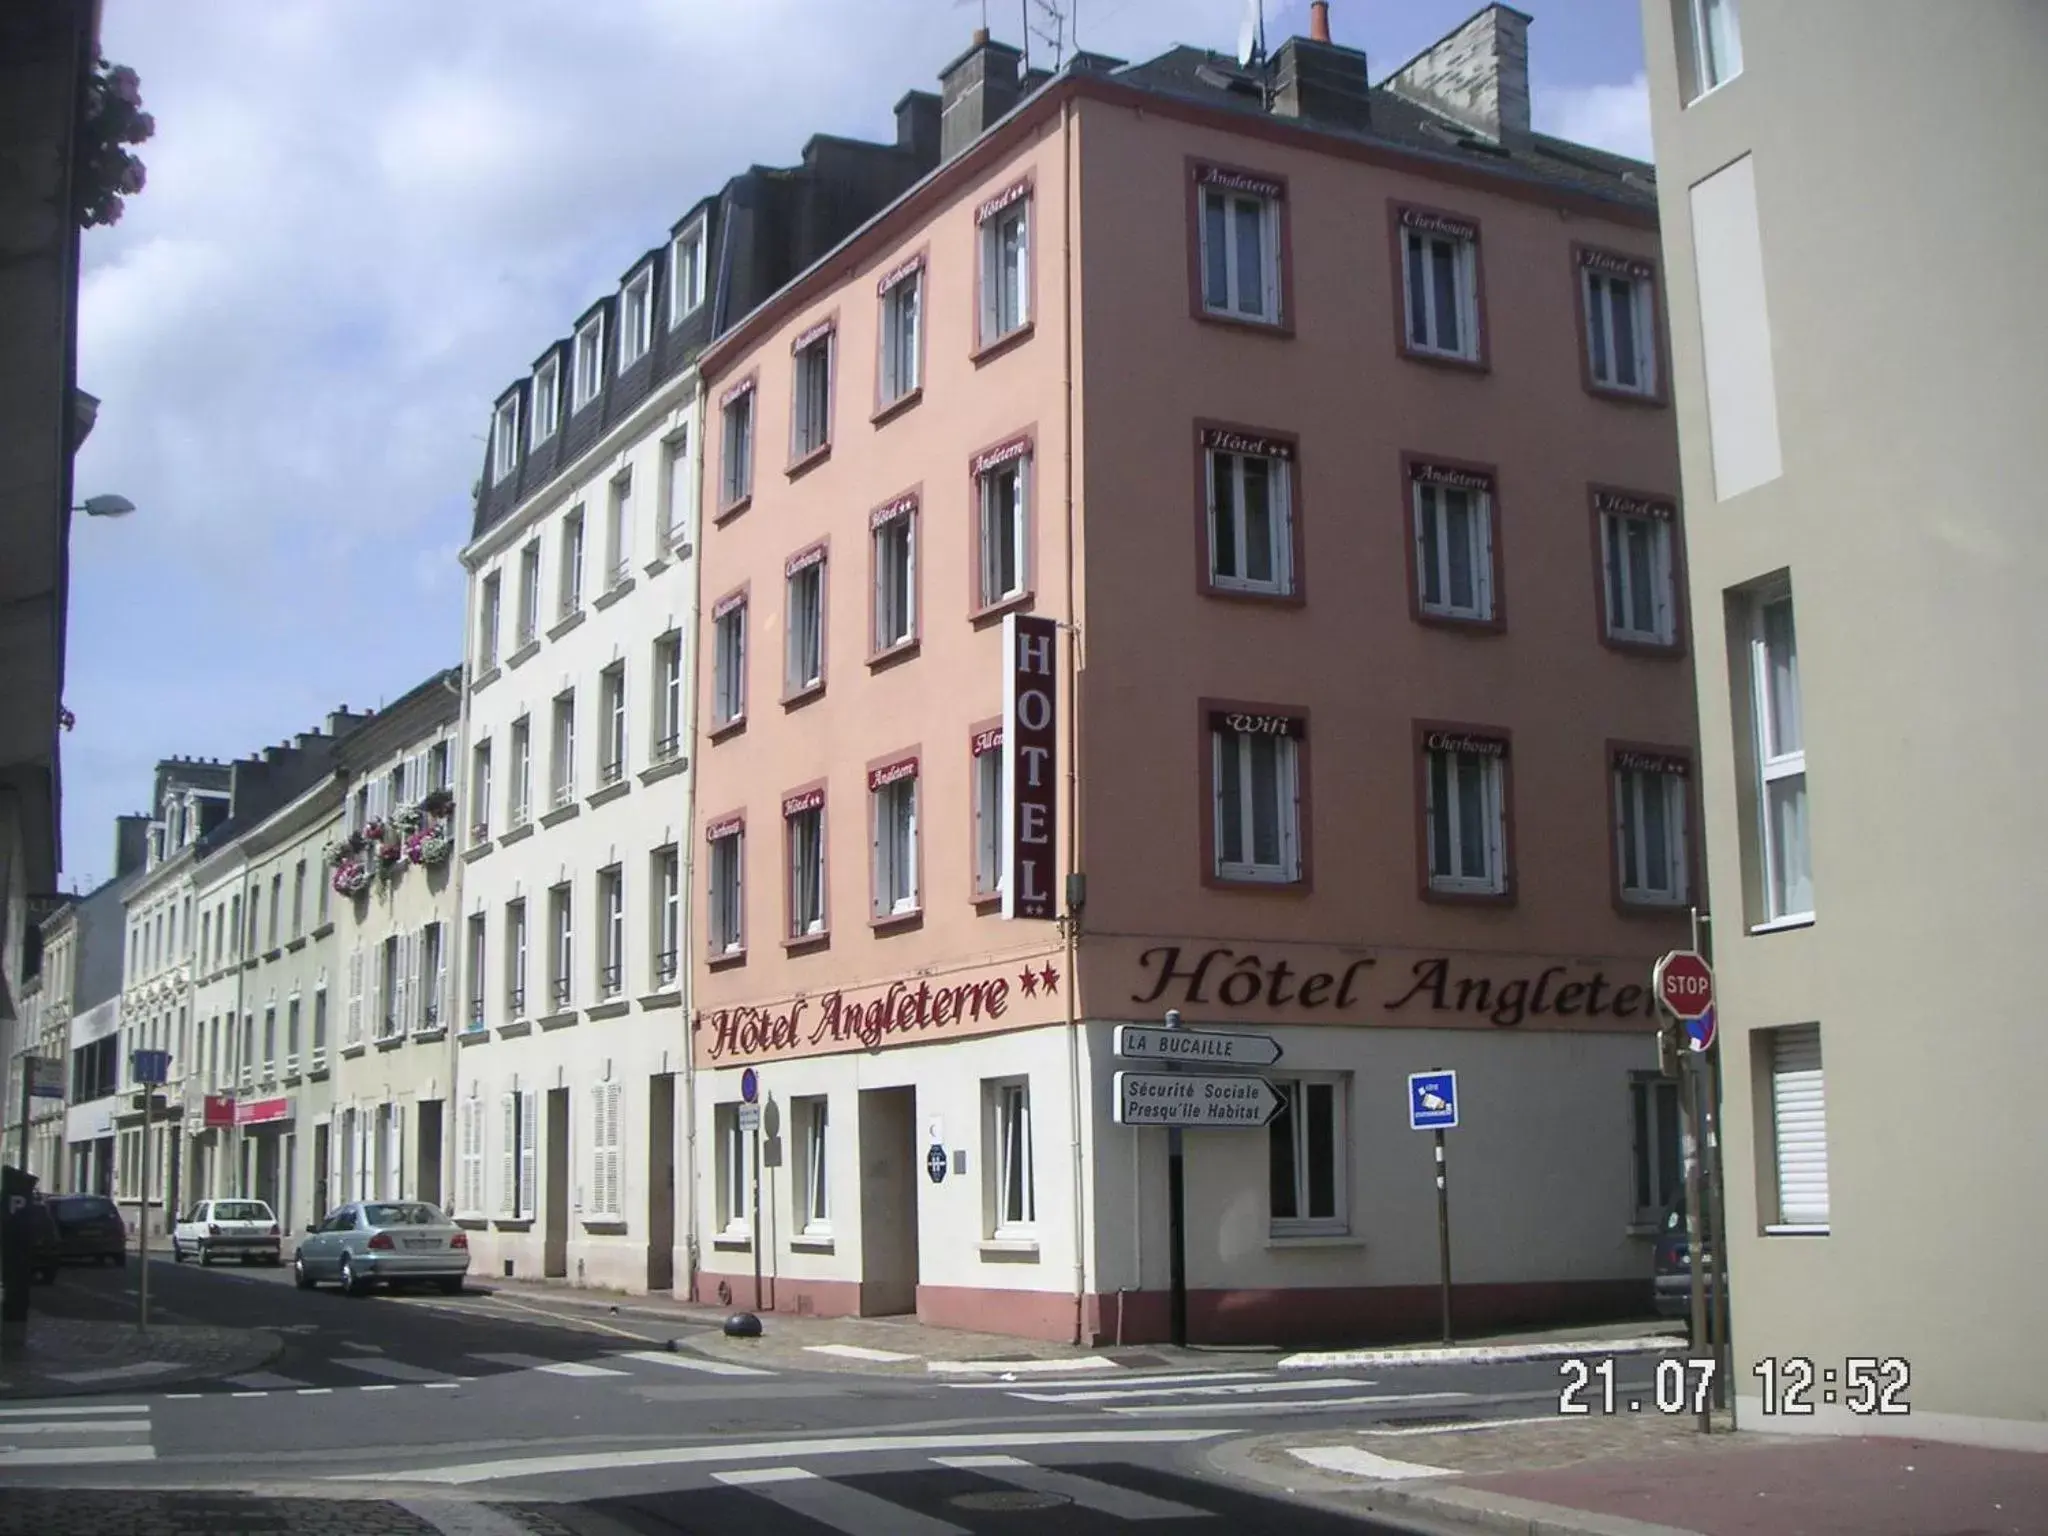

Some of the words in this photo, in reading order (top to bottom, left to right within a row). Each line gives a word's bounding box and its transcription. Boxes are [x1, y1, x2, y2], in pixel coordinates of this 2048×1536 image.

[1226, 714, 1289, 735] Wifi
[1018, 632, 1051, 901] HOTEL
[1131, 946, 1376, 1009] Hôtel
[1384, 957, 1659, 1027] Angleter
[1667, 975, 1708, 994] STOP
[708, 1000, 808, 1060] Hôtel
[808, 977, 1009, 1048] Angleterre
[1128, 1035, 1147, 1050] LA
[1159, 1037, 1233, 1056] BUCAILLE
[1128, 1081, 1195, 1098] Sécurité
[1204, 1084, 1259, 1099] Sociale
[1207, 1103, 1260, 1120] Habitat
